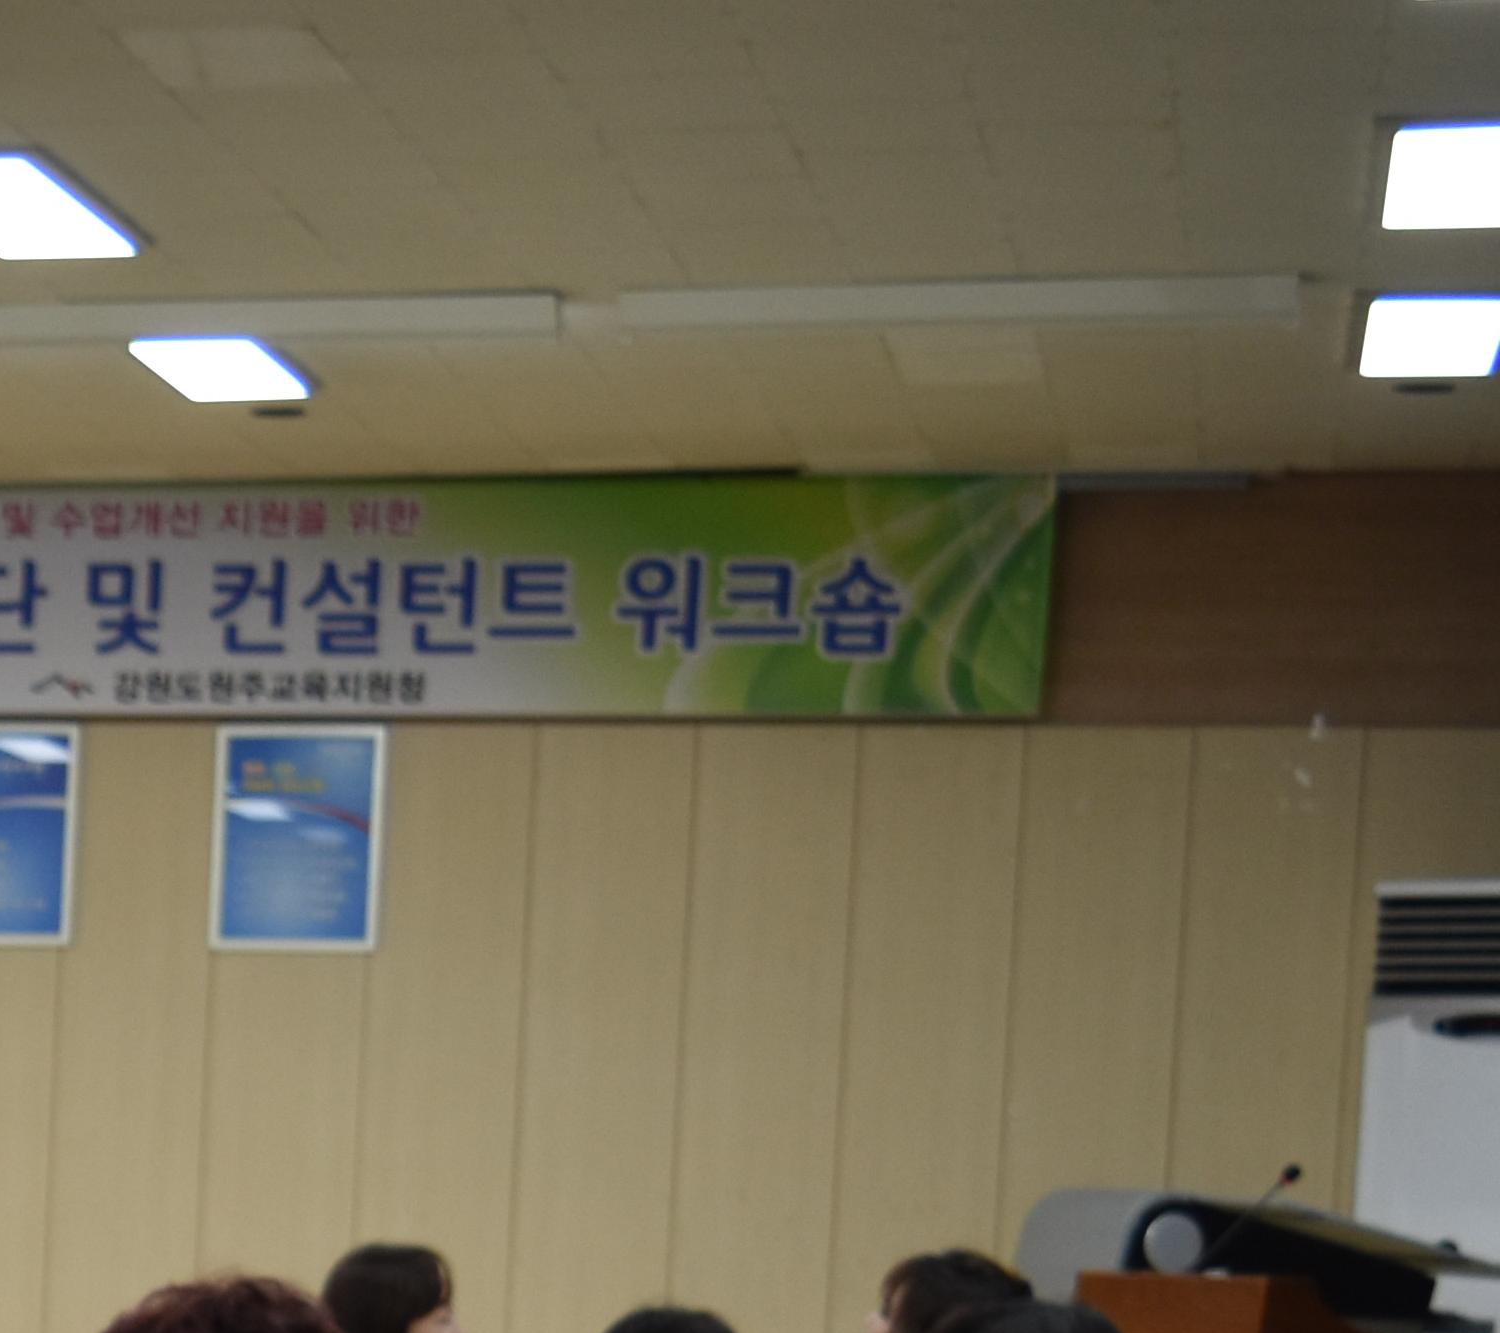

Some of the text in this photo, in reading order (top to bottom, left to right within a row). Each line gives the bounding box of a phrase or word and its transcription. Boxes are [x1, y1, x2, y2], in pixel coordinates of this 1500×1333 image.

[3, 500, 34, 538] 및
[53, 500, 200, 540] 수업개선
[220, 500, 327, 538] 지원을
[350, 499, 420, 537] 위한
[85, 558, 165, 655] 및
[211, 556, 575, 656] 컨설턴트
[616, 556, 901, 656] 워크숍
[114, 670, 427, 704] 강원도원주교육지원청
